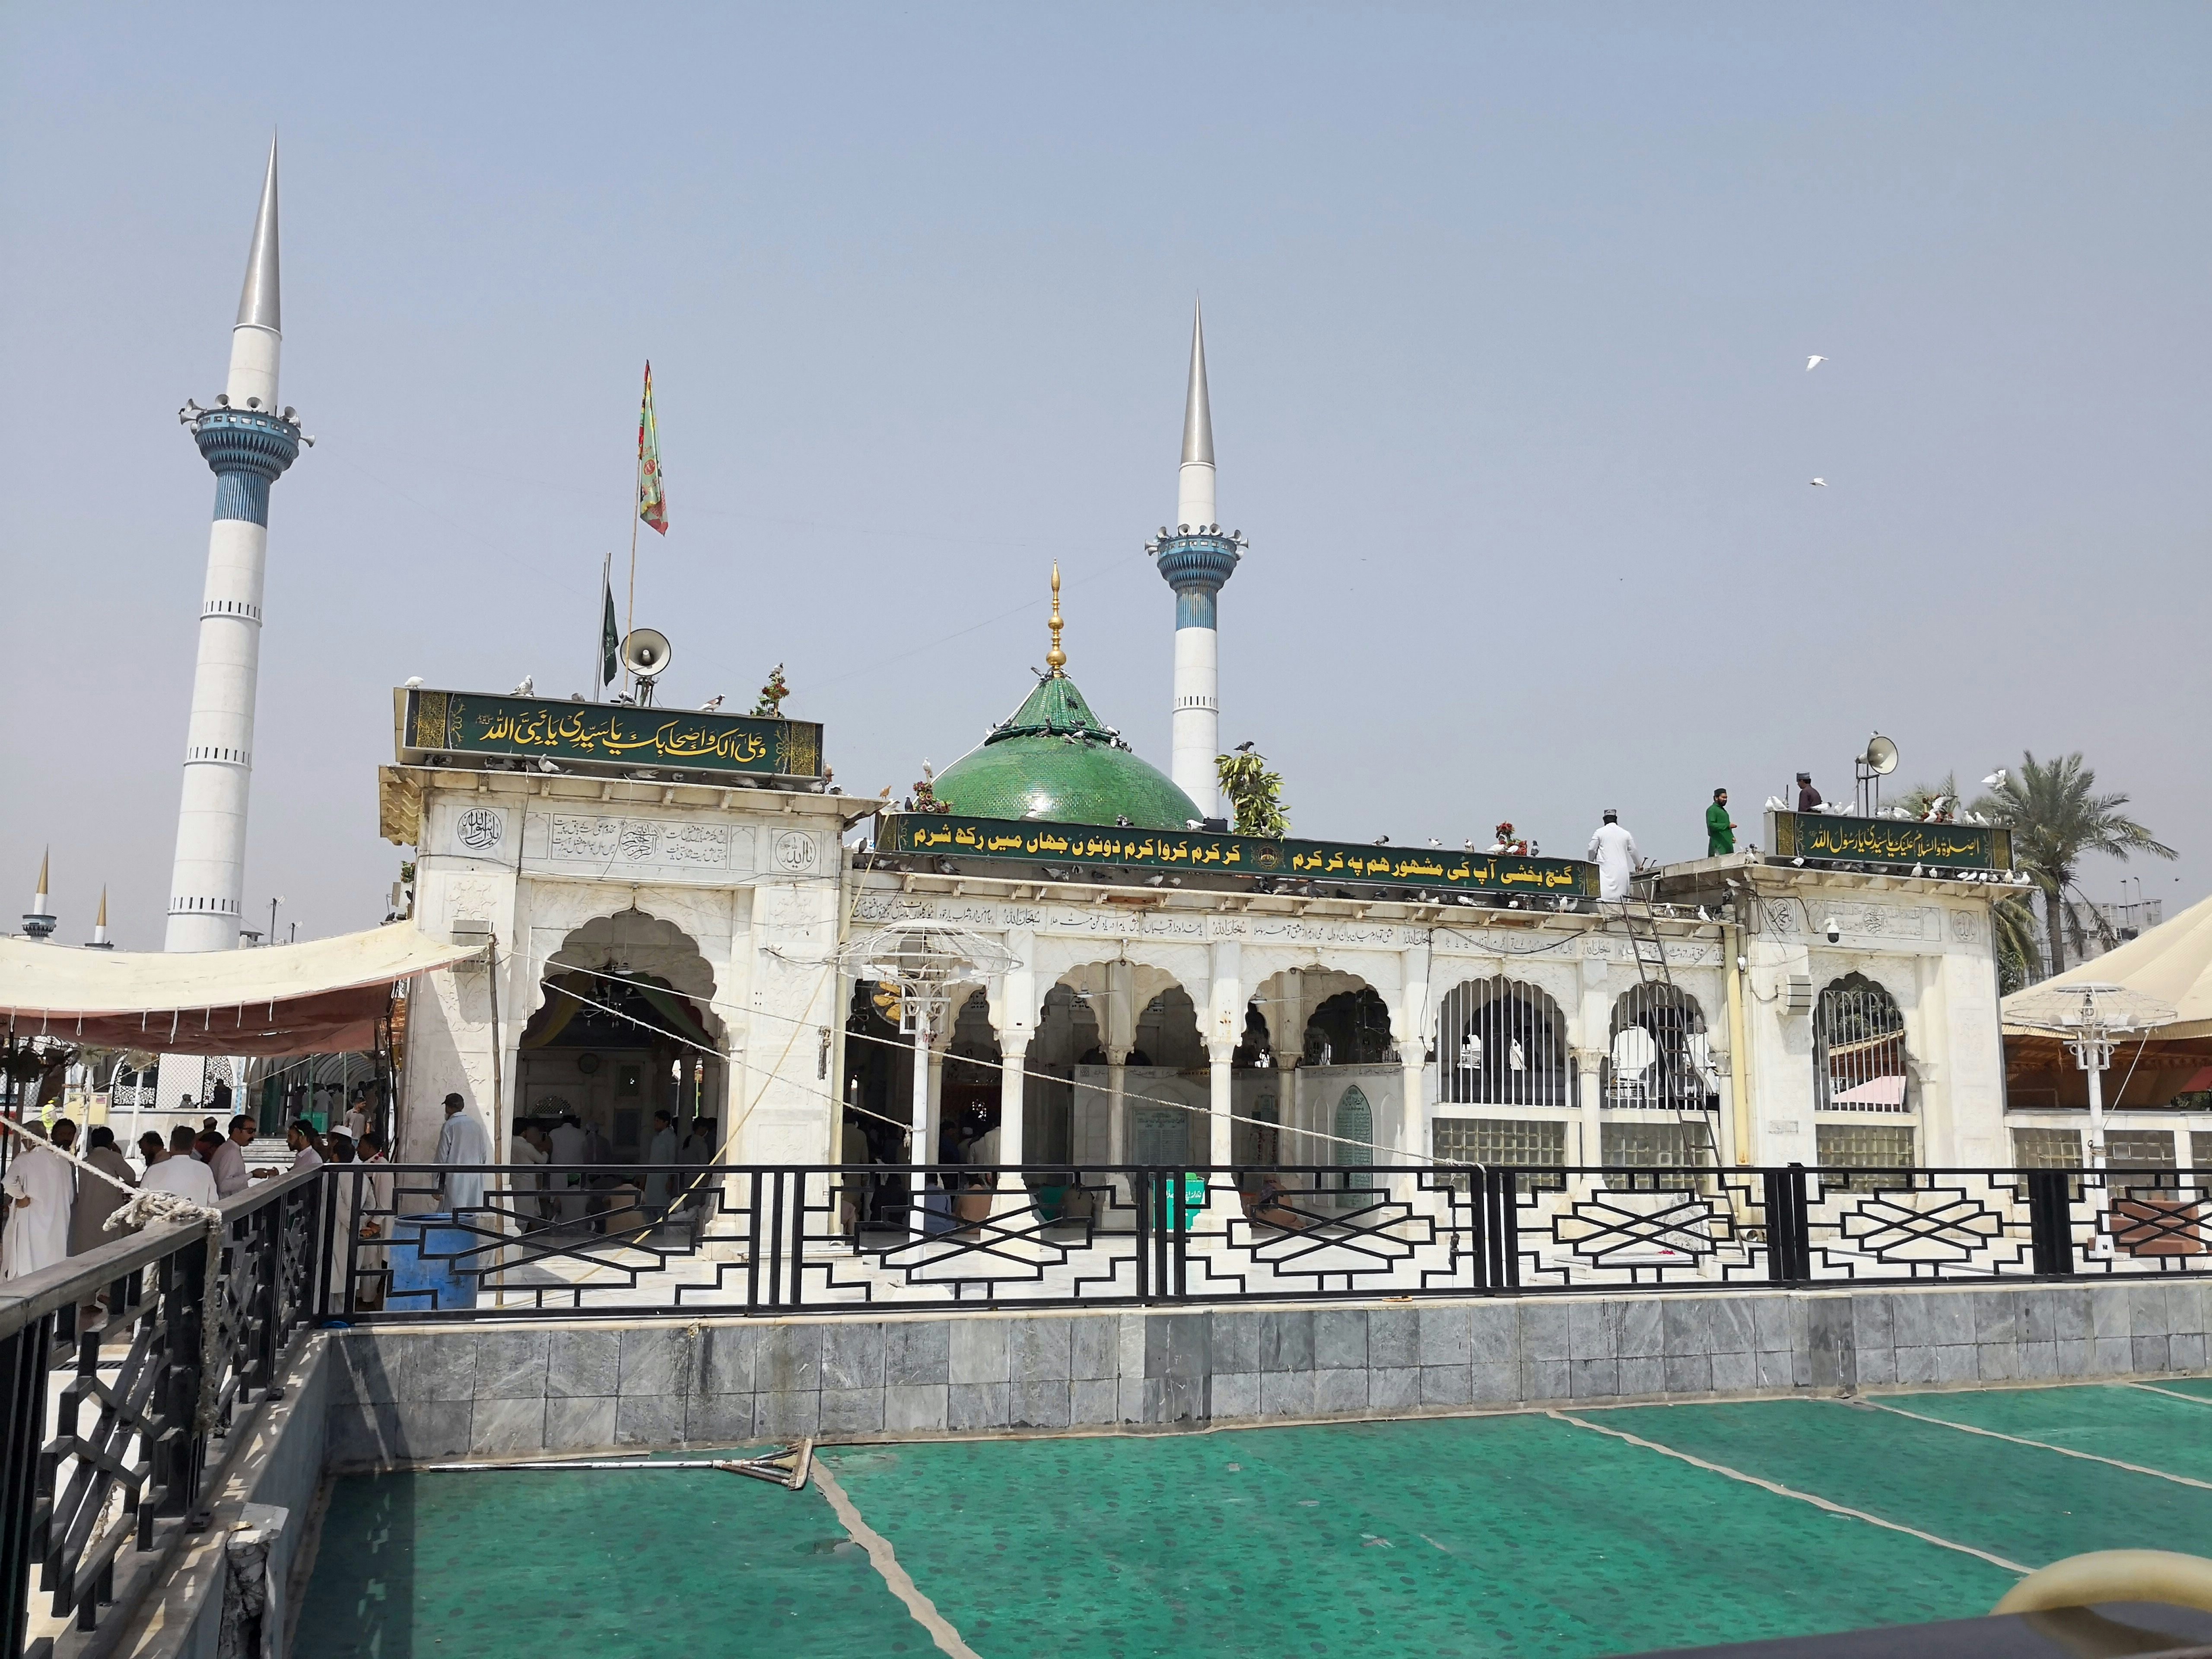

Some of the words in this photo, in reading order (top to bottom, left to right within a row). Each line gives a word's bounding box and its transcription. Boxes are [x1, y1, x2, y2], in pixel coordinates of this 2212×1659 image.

[914, 824, 951, 847] شرم
[955, 826, 984, 849] رکھ
[988, 834, 1023, 851] میں
[1125, 838, 1154, 861] کرم
[1157, 839, 1187, 861] کروا
[1192, 842, 1220, 864] کرم
[1222, 844, 1240, 864] کر
[1293, 850, 1322, 871] کرم
[1324, 852, 1344, 871] کر
[1447, 861, 1469, 880] کی
[1473, 858, 1497, 885] آپ
[1501, 864, 1543, 886] بخشی
[1545, 865, 1573, 887] گنج
